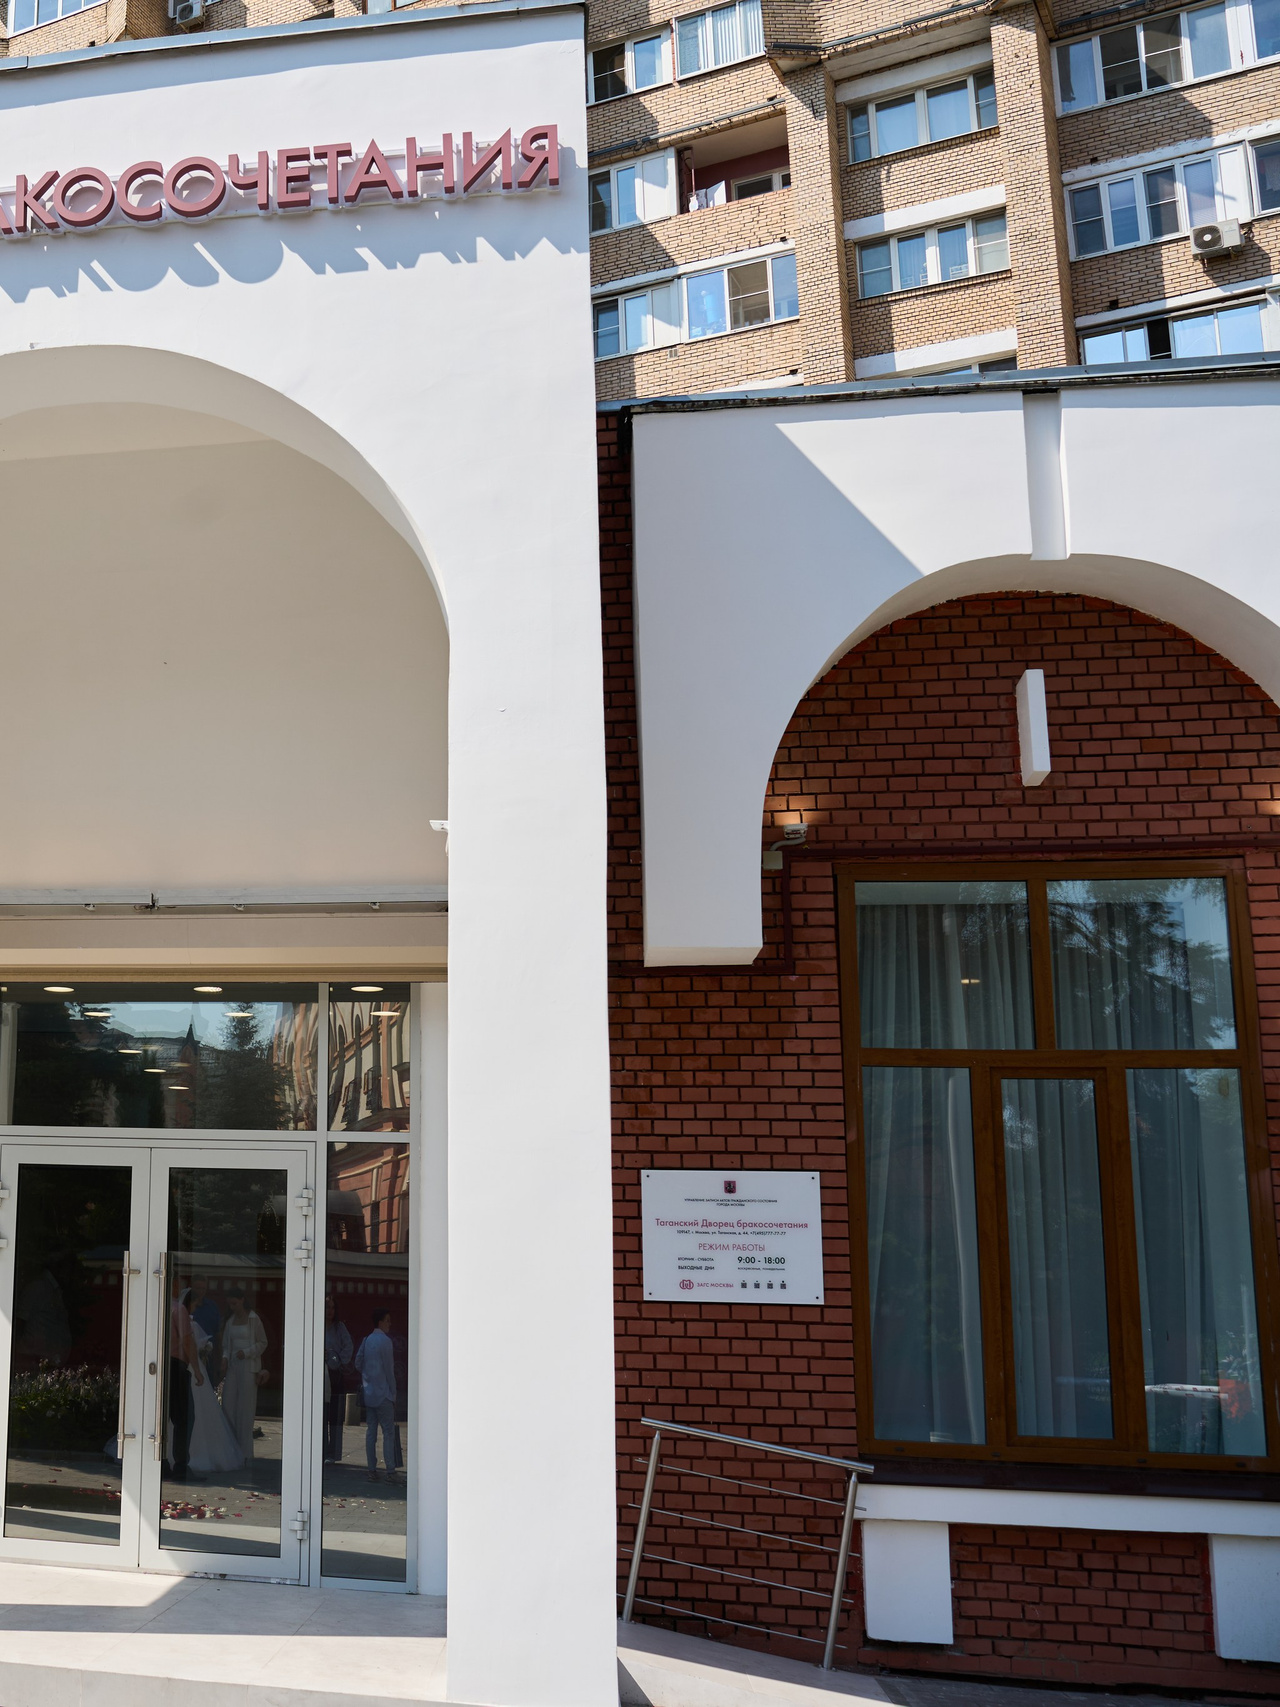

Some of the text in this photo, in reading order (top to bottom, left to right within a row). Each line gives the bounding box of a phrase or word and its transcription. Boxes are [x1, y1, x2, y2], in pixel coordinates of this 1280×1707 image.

[655, 1218, 808, 1229] Таганский Дворец бракосочетания
[698, 1243, 766, 1252] РЕЖИМ РАБОТЫ
[737, 1256, 756, 1264] 9:00
[763, 1256, 786, 1265] 18:00
